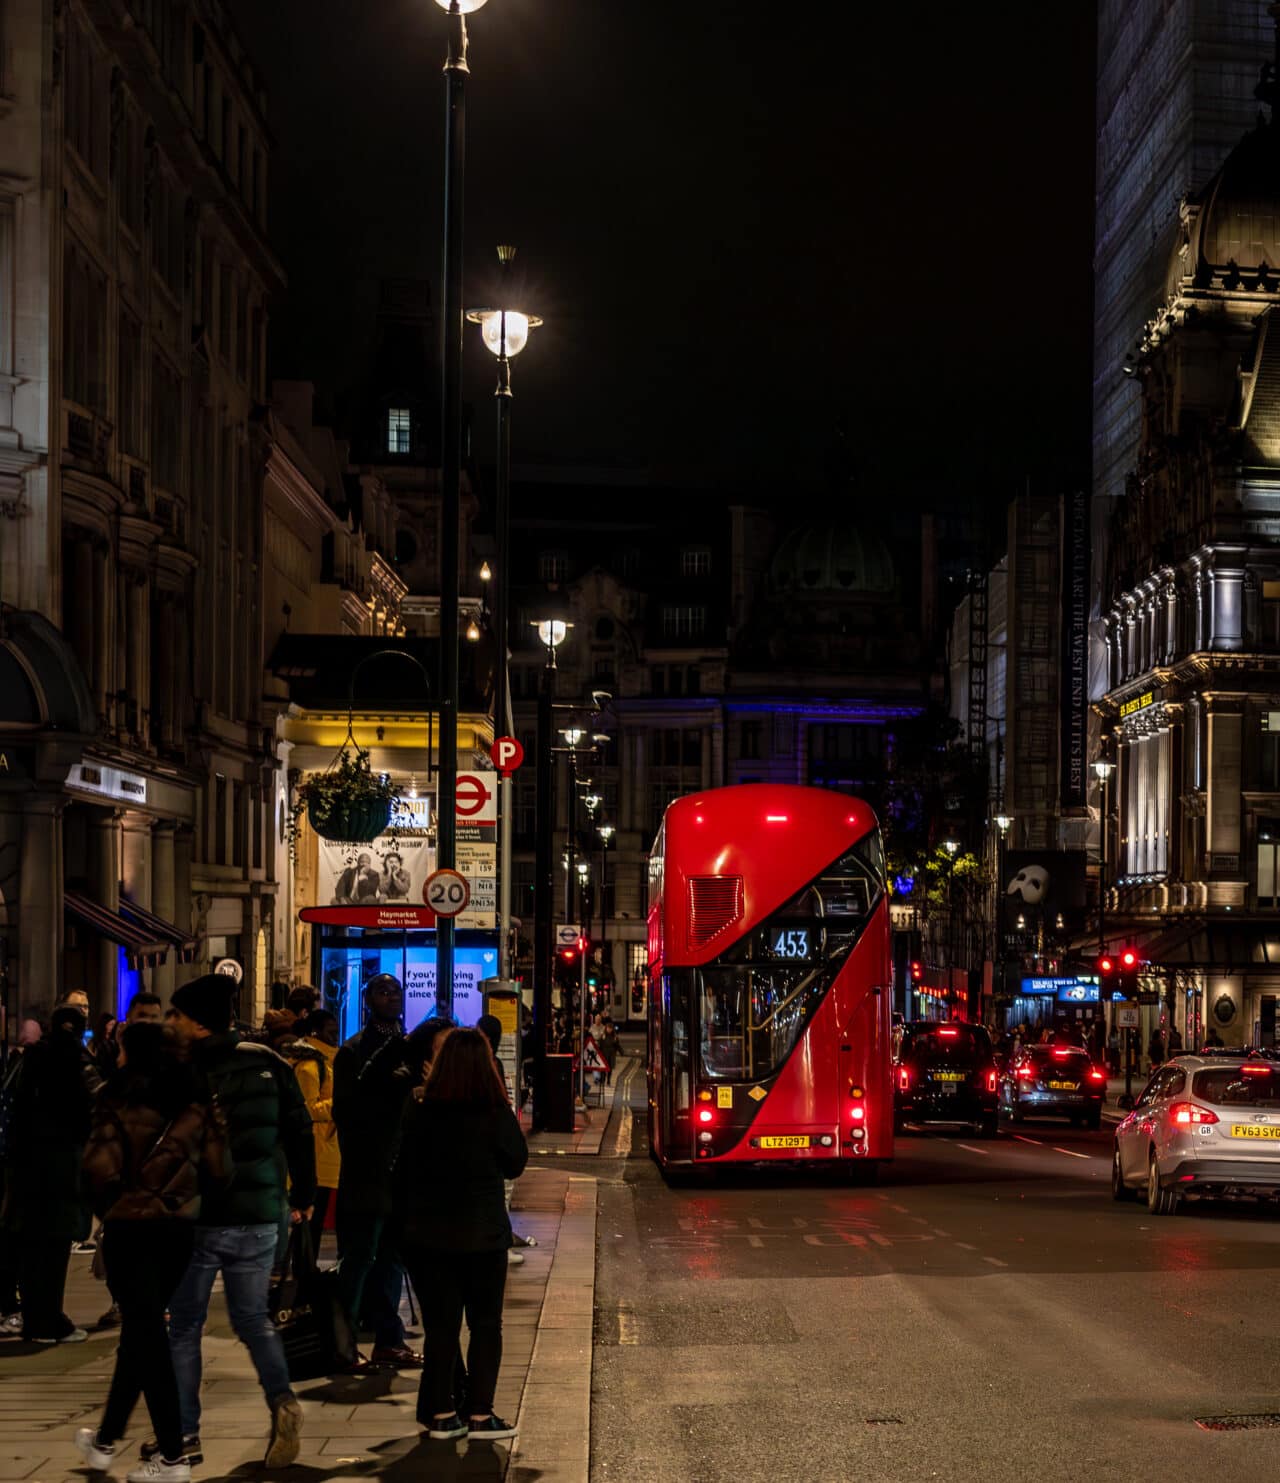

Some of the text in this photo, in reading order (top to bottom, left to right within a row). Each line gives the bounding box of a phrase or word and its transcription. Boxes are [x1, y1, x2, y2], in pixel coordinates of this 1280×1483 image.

[1071, 600, 1086, 631] THE
[1071, 633, 1085, 673] WEST
[1071, 676, 1084, 706] END
[1070, 710, 1083, 727] AT
[499, 742, 516, 766] P
[1070, 731, 1082, 755] ITS
[1070, 757, 1082, 791] BEST
[431, 883, 464, 903] 20
[380, 911, 417, 919] Haymarket
[775, 931, 807, 958] 453
[454, 971, 474, 981] ying
[408, 990, 431, 998] since
[1201, 1126, 1211, 1134] GB
[1234, 1127, 1260, 1136] FV63
